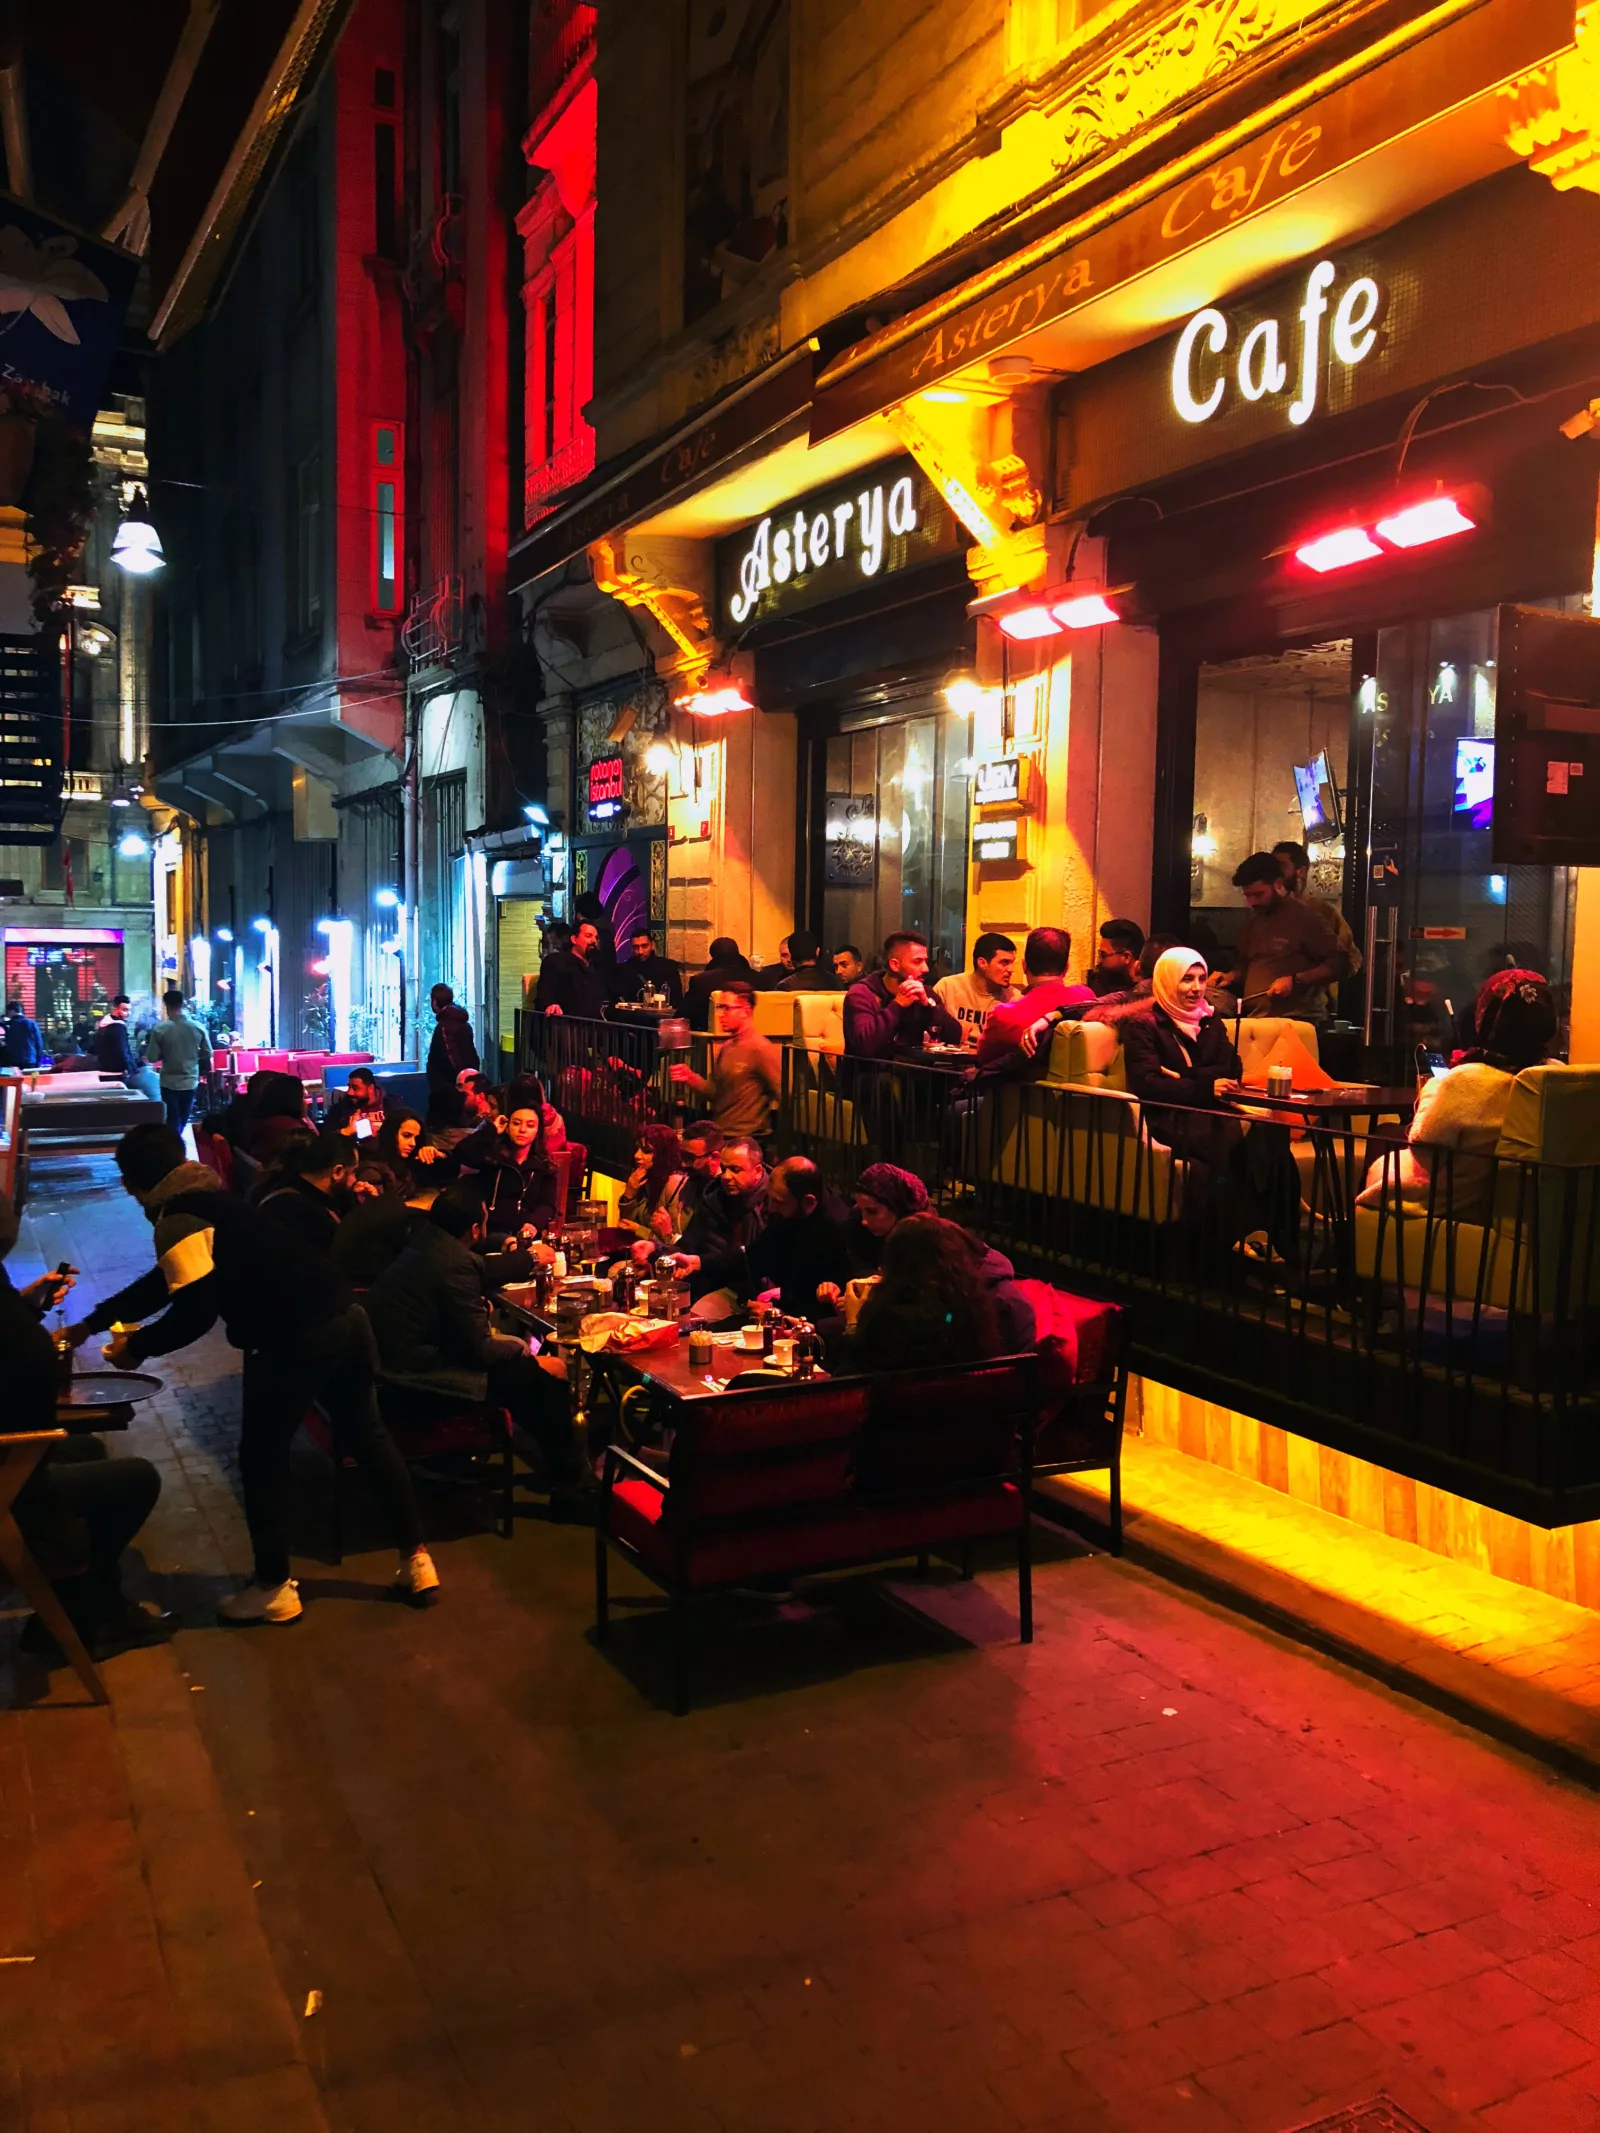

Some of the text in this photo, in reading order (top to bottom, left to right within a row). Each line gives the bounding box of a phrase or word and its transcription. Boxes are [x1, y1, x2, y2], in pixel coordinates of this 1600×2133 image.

[910, 120, 1322, 379] Asterya Cafe
[1171, 260, 1380, 425] Cafe
[660, 427, 716, 484] Cafe
[730, 475, 917, 623] Asterya
